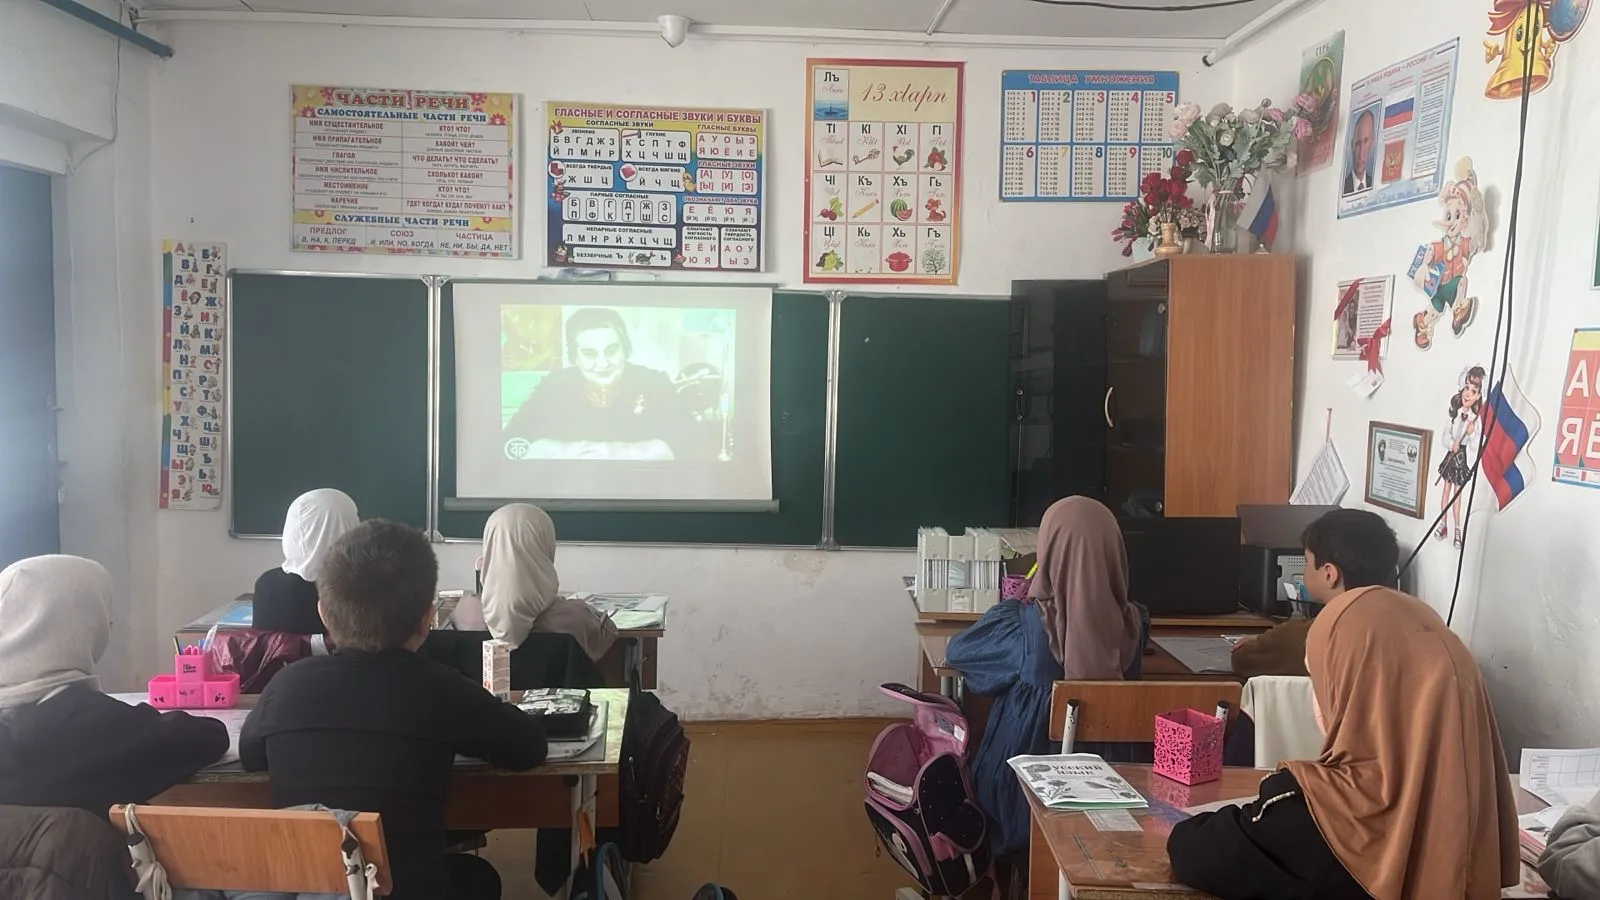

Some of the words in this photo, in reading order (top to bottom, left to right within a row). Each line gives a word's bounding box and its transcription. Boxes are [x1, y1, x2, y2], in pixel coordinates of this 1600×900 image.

[824, 72, 839, 81] Лъ
[1029, 74, 1077, 85] ТАБЛИЦА
[1084, 74, 1154, 84] УМНОЖЕНИЯ
[862, 83, 886, 102] 13
[1031, 92, 1035, 102] 1
[1063, 92, 1070, 103] 2
[1097, 92, 1104, 103] 3
[1131, 92, 1139, 103] 4
[336, 93, 406, 106] ЧАСТИ
[416, 97, 468, 109] РЕЧИ
[1166, 93, 1173, 103] 5
[318, 108, 418, 120] САМОСТОЯТЕЛЬНЫЕ
[423, 113, 455, 121] ЧАСТИ
[555, 108, 602, 118] ГЛАСНЫЕ
[616, 110, 678, 120] СОГЛАСНЫЕ
[682, 112, 714, 121] ЗВУКИ
[727, 115, 761, 123] БУКВЫ
[324, 121, 383, 129] СУЩЕСТВИТЕЛЬНОЕ
[328, 136, 382, 144] ПРИЛАГАТЕЛЬНОЕ
[1026, 147, 1033, 158] 6
[1062, 147, 1068, 157] 7
[1096, 147, 1102, 158] 8
[1129, 147, 1137, 158] 9
[1162, 147, 1172, 158] 10
[700, 170, 712, 179] [А]
[722, 171, 733, 179] [У]
[858, 176, 872, 185] Къ
[893, 176, 908, 186] Хъ
[930, 177, 941, 186] Гь
[334, 214, 400, 224] СЛУЖЕБНЫЕ
[443, 218, 469, 226] РЕЧИ
[310, 227, 348, 235] ПРЕДЛОГ
[858, 227, 870, 237] Кь
[892, 227, 906, 237] Хь
[928, 228, 940, 237] Гъ
[332, 237, 356, 245] ПЕРЕД
[456, 233, 493, 241] ЧАСТИЦА
[175, 243, 185, 253] А
[202, 249, 209, 259] Б
[182, 259, 189, 269] В
[174, 275, 183, 285] Д
[201, 279, 208, 288] Е
[174, 306, 181, 316] З
[200, 312, 209, 322] И
[205, 328, 212, 338] К
[180, 355, 188, 365] Н
[1566, 360, 1589, 397] А
[180, 387, 186, 397] С
[181, 416, 189, 426] Х
[200, 437, 209, 446] Ш
[1558, 417, 1582, 456] Я
[202, 484, 212, 493] Ю
